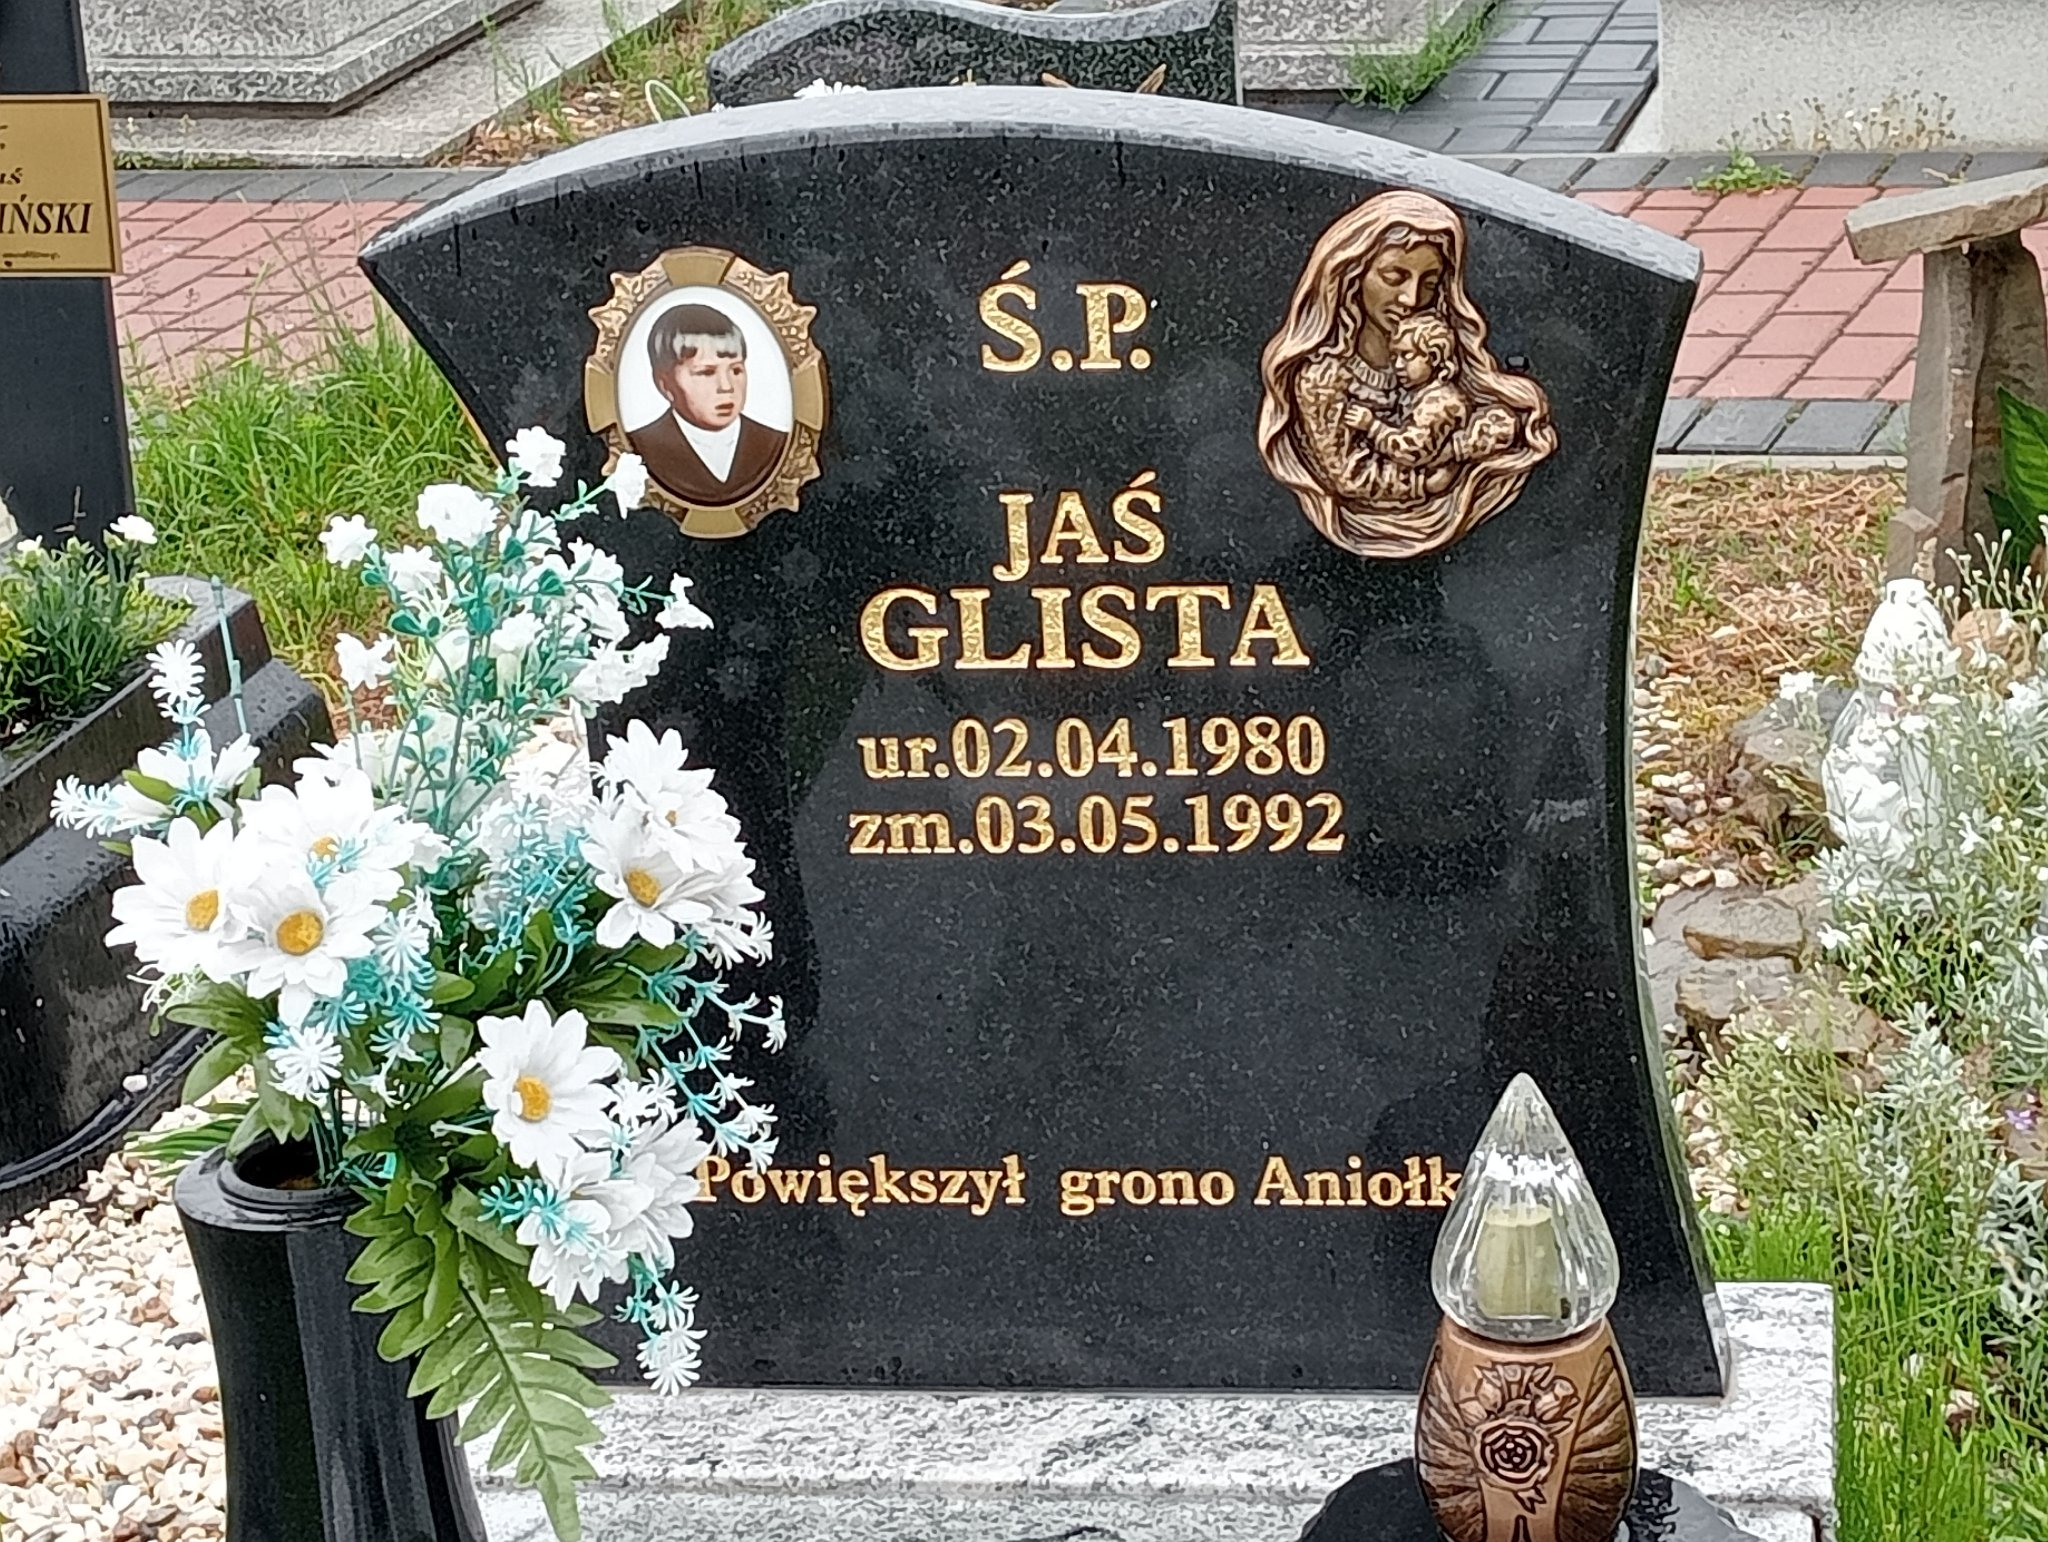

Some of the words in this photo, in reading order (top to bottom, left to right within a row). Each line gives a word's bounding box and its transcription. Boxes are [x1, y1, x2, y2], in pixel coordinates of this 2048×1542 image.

[980, 260, 1152, 372] Ś.P.
[992, 471, 1167, 582] JAŚ
[859, 584, 1311, 671] GLISTA
[857, 715, 1326, 779] ur.02.04.1980
[849, 792, 1346, 855] zm.03.05.1992
[695, 1154, 1026, 1217] Powiększył
[1059, 1169, 1236, 1217] grono
[1253, 1155, 1462, 1207] Aniołk
